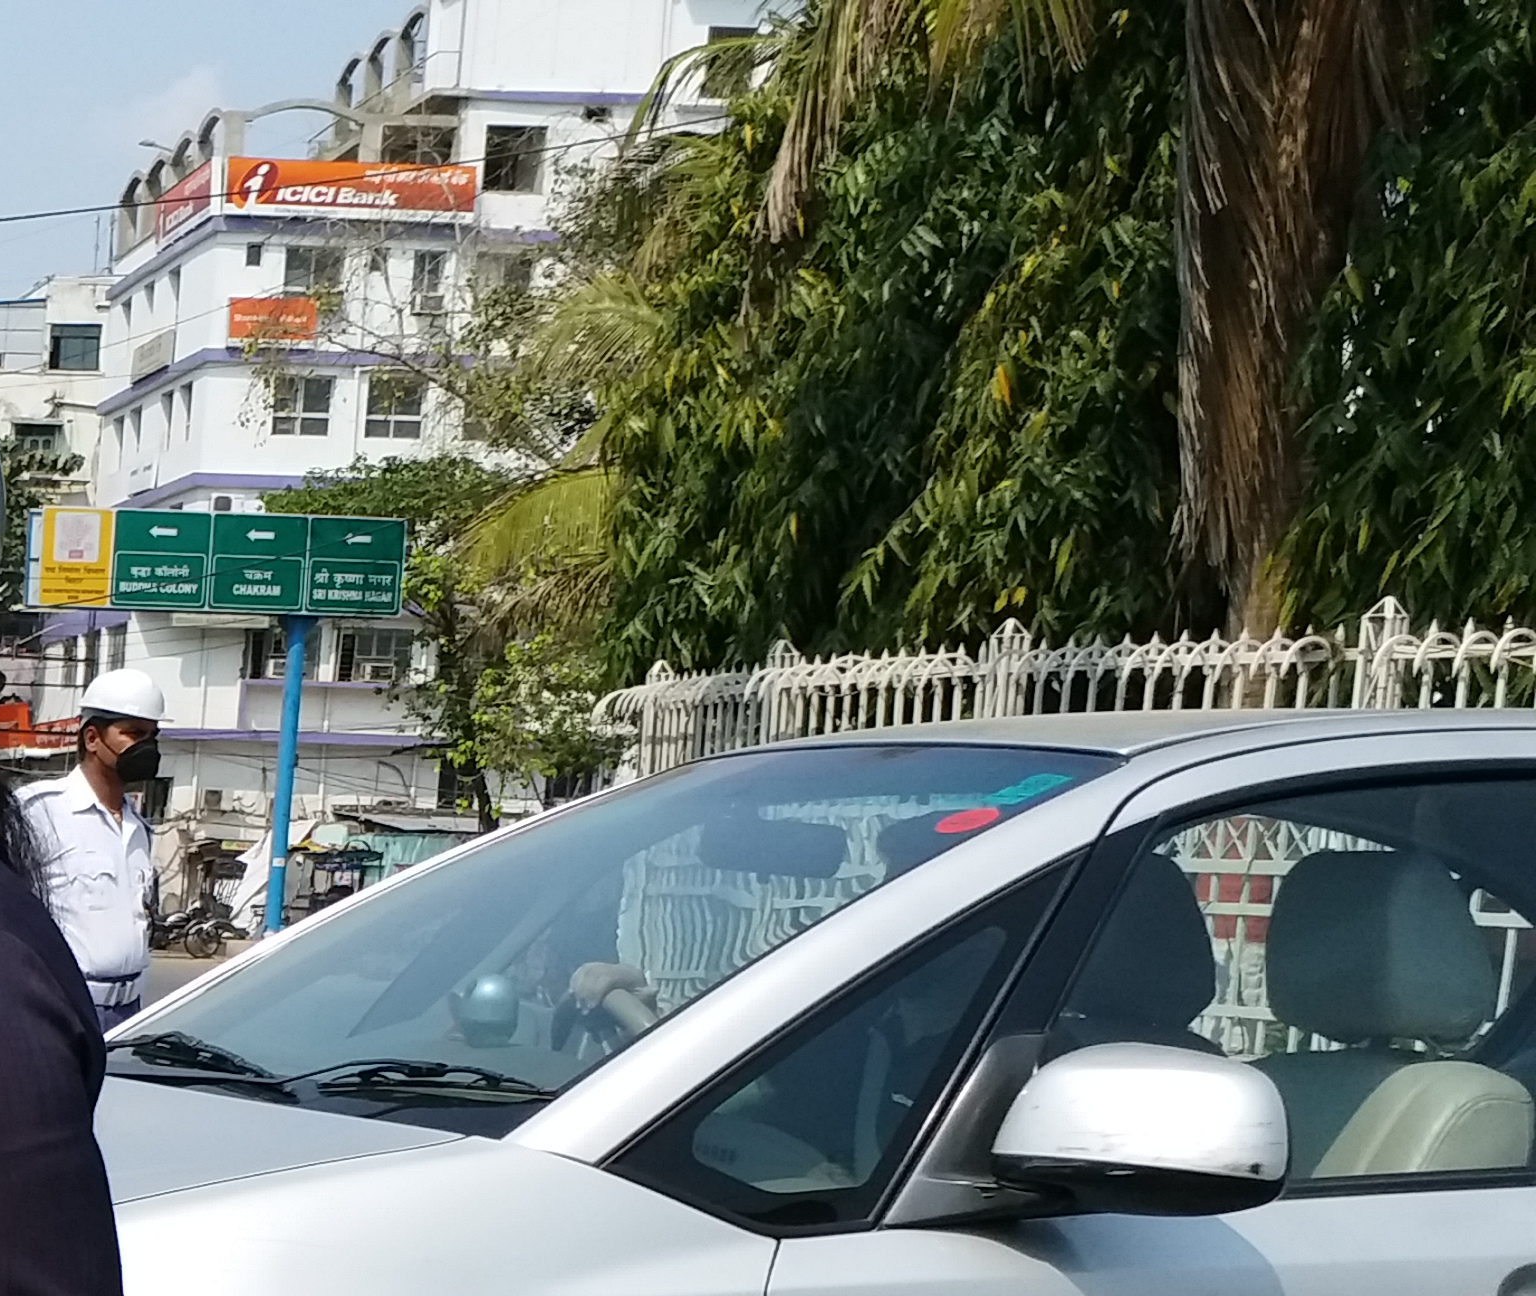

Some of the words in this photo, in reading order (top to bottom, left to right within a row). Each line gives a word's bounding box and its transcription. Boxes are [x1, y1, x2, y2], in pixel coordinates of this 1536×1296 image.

[276, 186, 336, 202] ICICI
[336, 187, 400, 206] Bank
[313, 567, 330, 585] श्री
[367, 574, 394, 586] नगर
[159, 582, 199, 595] COLONY
[232, 584, 281, 597] CHAKRAM
